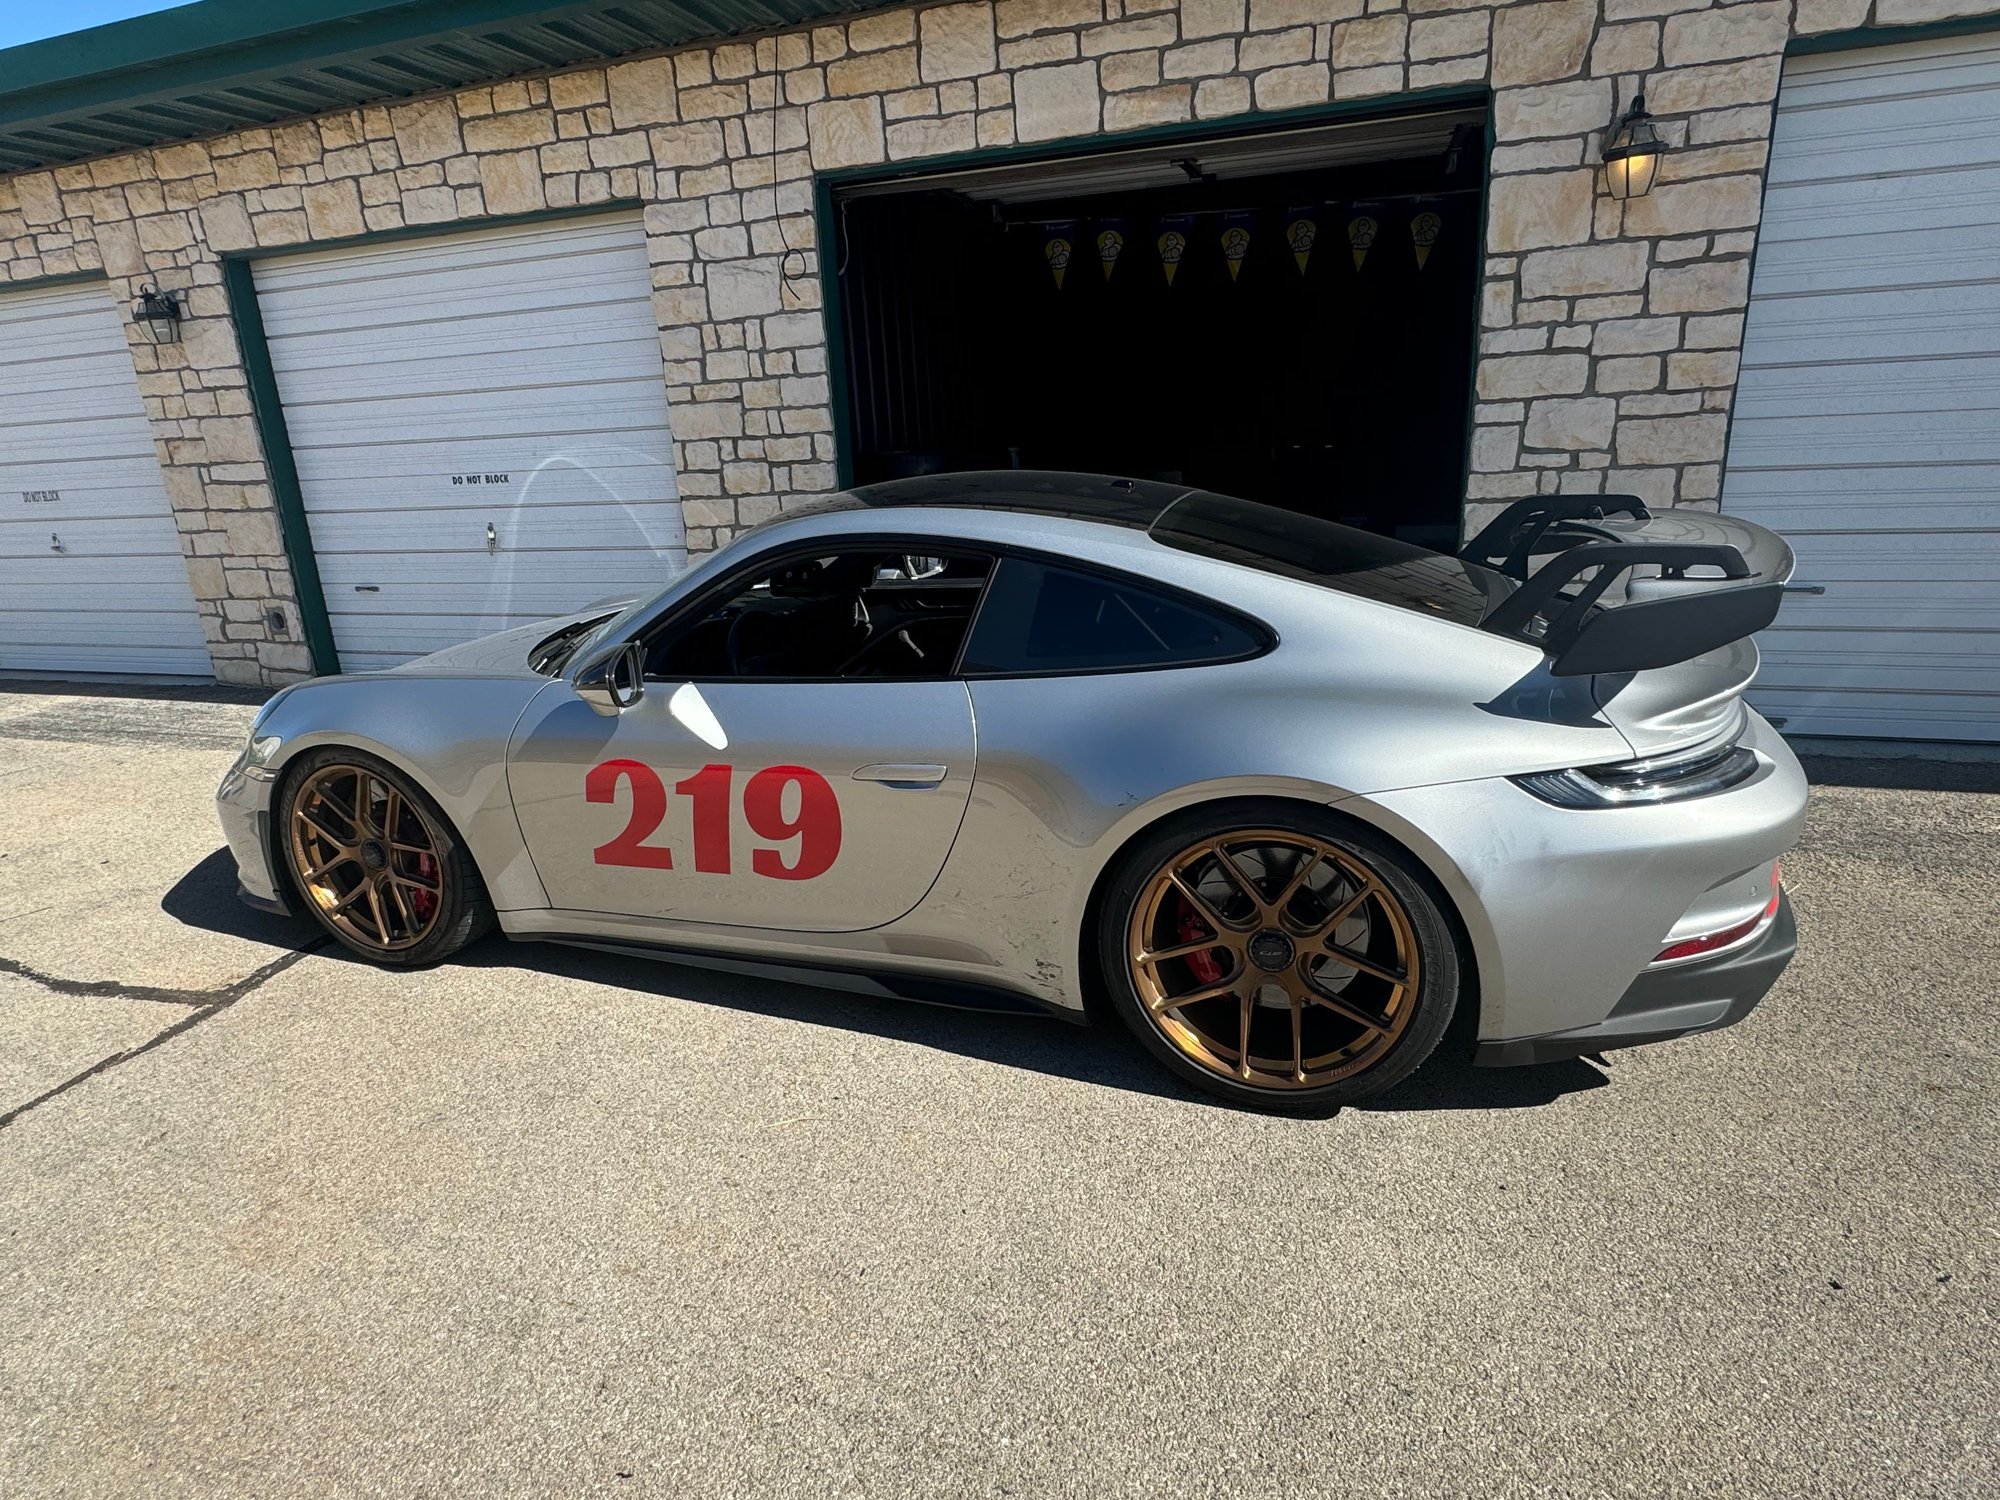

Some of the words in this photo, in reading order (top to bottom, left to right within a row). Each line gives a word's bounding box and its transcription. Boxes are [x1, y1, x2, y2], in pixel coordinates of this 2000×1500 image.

[452, 476, 463, 485] DO
[466, 475, 481, 484] NOT
[485, 474, 510, 484] BLOCK
[585, 759, 842, 881] 219
